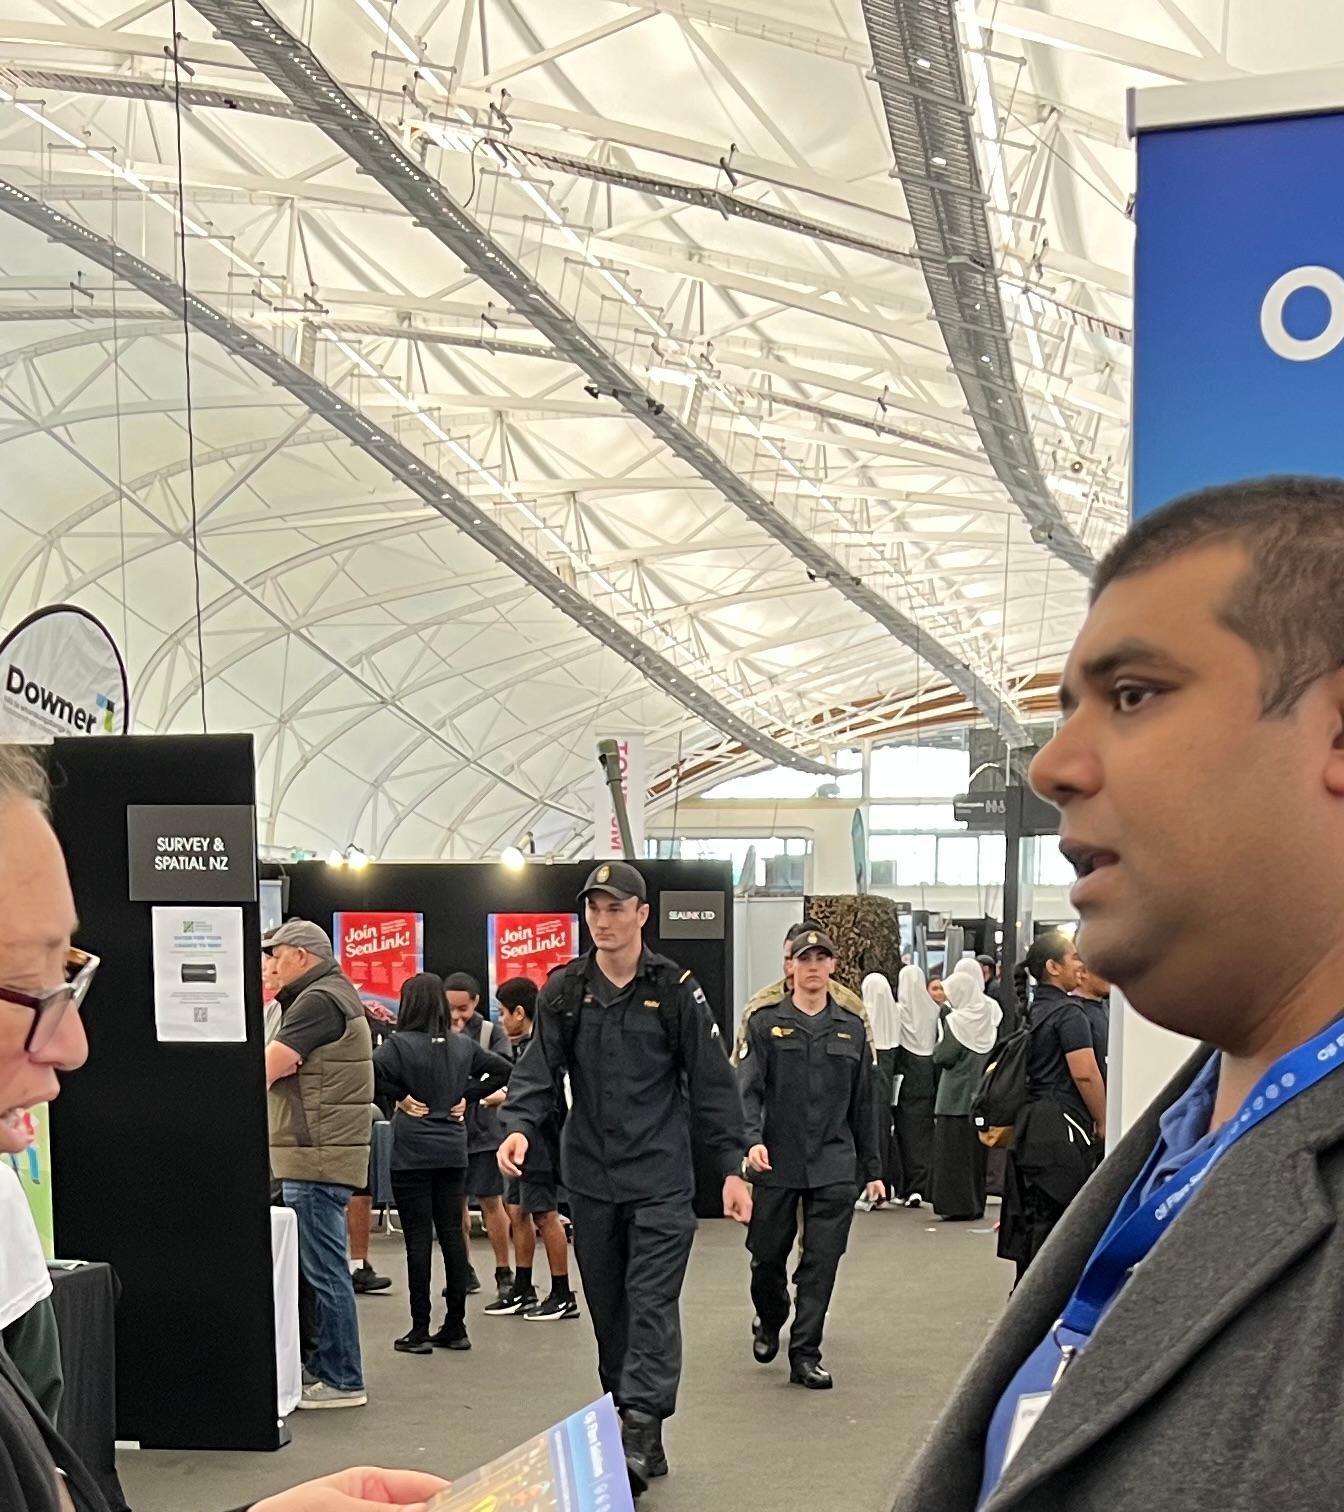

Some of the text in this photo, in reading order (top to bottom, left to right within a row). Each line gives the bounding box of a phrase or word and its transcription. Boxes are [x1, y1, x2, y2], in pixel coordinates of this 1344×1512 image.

[6, 664, 97, 734] Downer
[156, 836, 225, 852] SURVEY &
[154, 856, 229, 871] SPATIAL NZ
[345, 924, 377, 943] Join
[500, 926, 533, 944] Join
[345, 931, 410, 958] SeaLink!
[500, 932, 566, 960] SeaLink!
